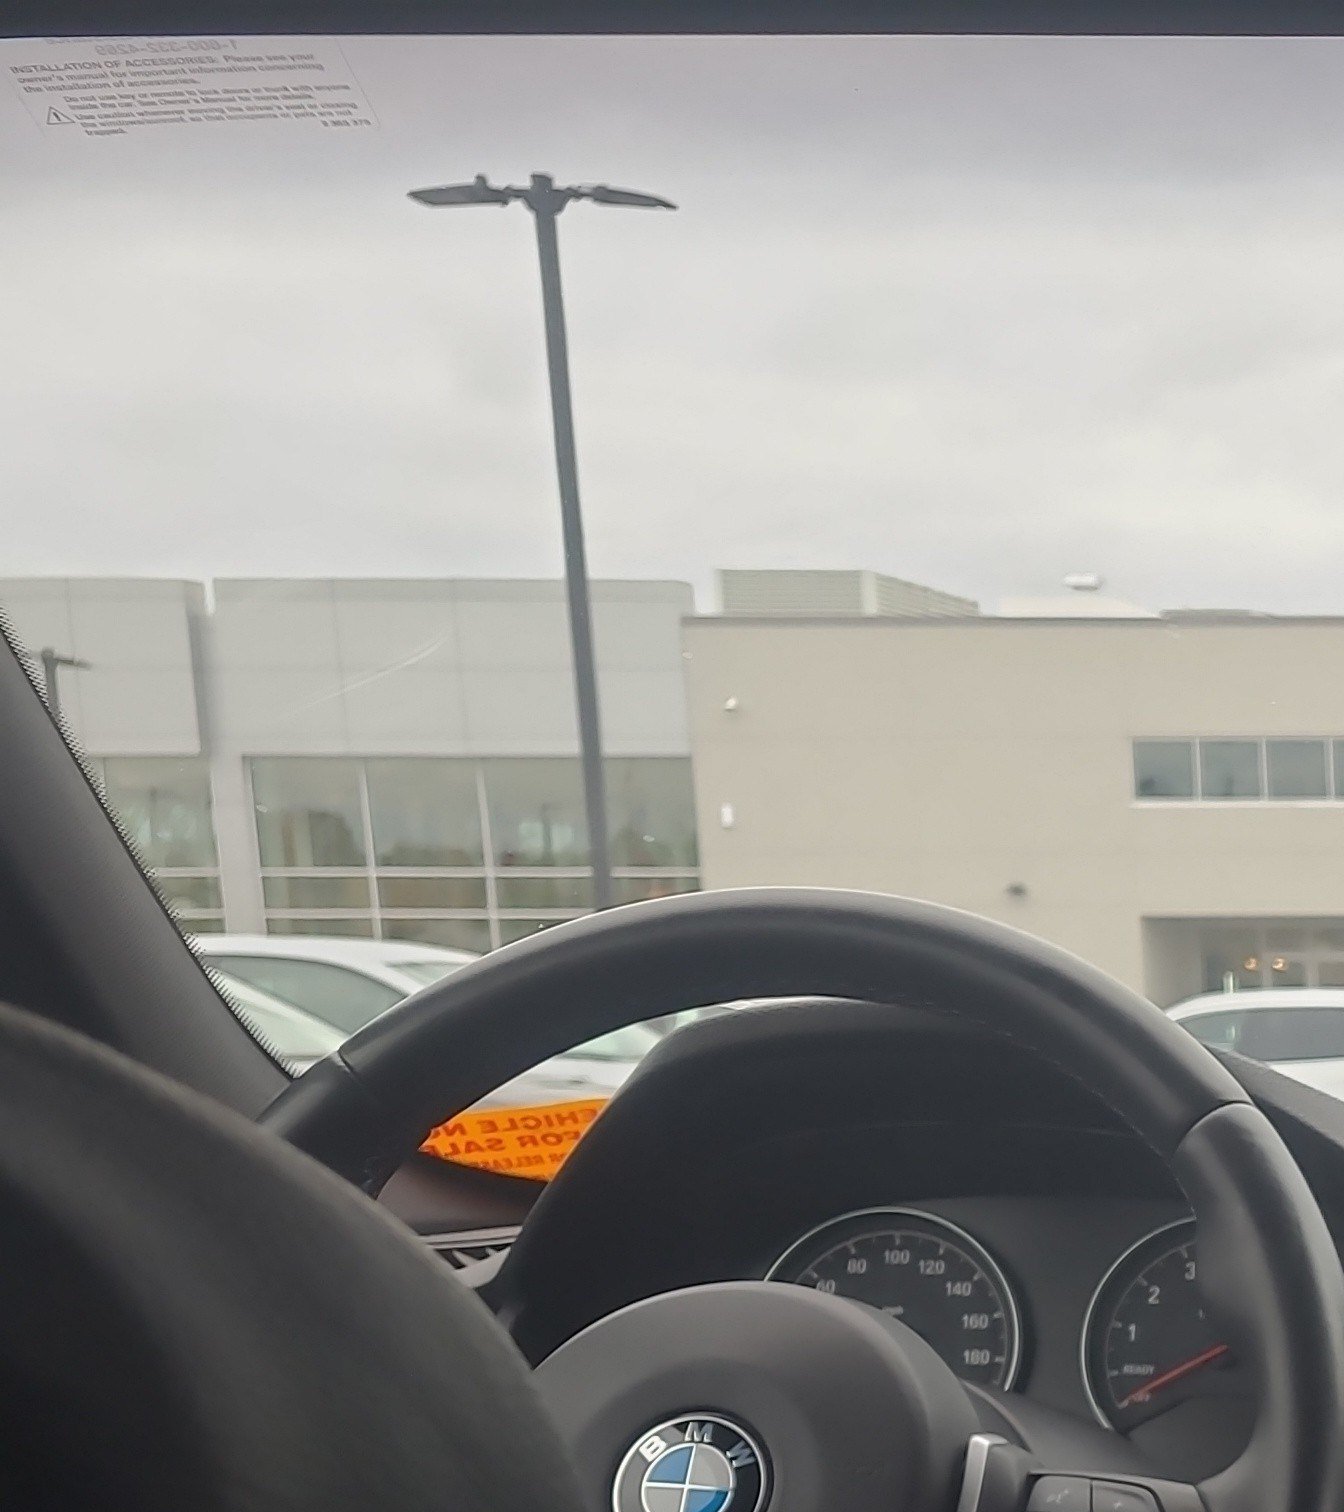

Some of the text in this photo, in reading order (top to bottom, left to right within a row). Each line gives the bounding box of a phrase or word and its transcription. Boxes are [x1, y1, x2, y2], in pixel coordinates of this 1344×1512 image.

[9, 61, 101, 74] INSTALLATION
[104, 60, 120, 68] OF
[126, 55, 218, 67] ACCESSORIES:
[223, 54, 264, 62] Please
[65, 70, 108, 80] manual
[128, 66, 187, 77] important
[188, 63, 257, 75] information
[883, 1248, 910, 1264] 100
[846, 1258, 867, 1274] 80
[918, 1259, 945, 1275] 120
[1183, 1262, 1197, 1281] 3
[945, 1281, 972, 1297] 140
[1147, 1286, 1161, 1305] 2
[961, 1313, 989, 1329] 160
[1127, 1324, 1137, 1343] 1
[962, 1350, 991, 1366] 180
[638, 1421, 756, 1469] BMW
